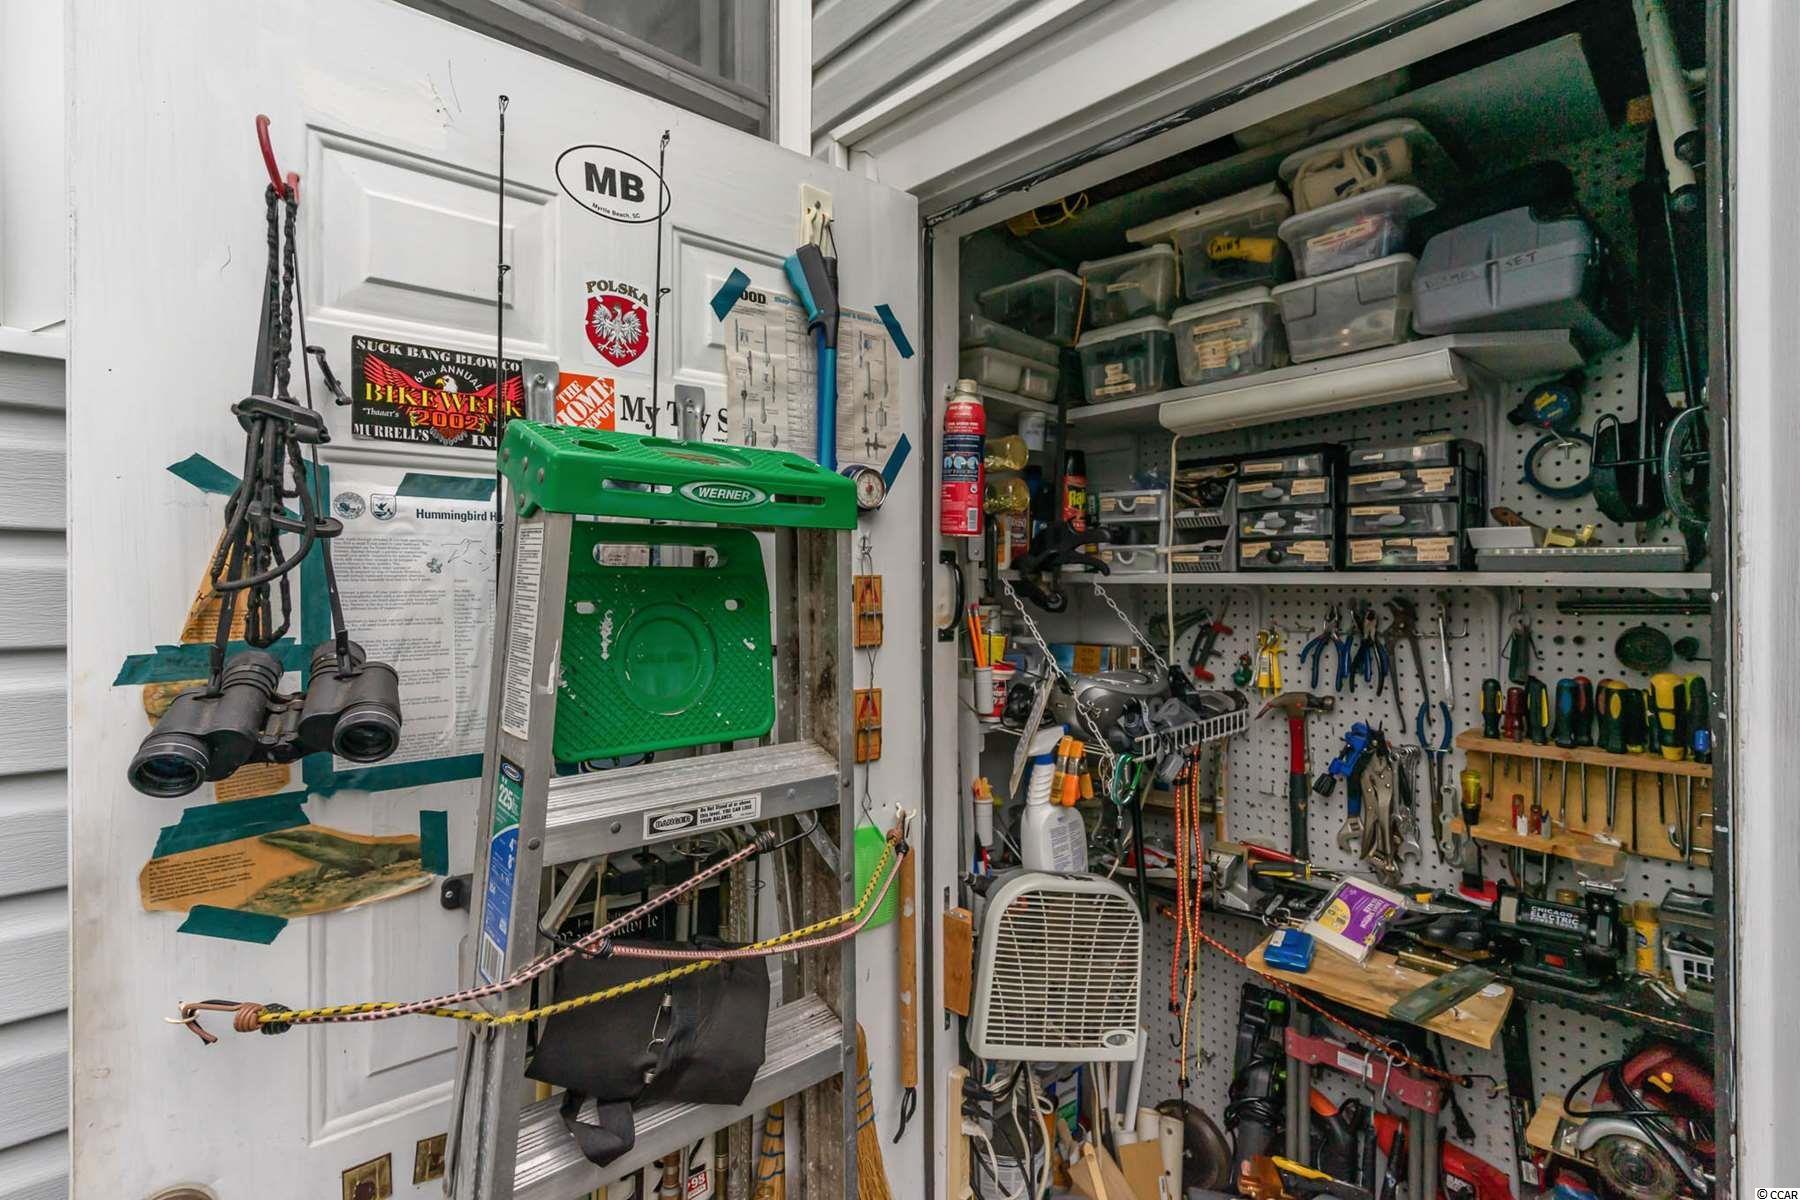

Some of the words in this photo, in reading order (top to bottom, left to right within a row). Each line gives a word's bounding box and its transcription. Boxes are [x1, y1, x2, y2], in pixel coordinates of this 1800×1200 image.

[584, 161, 645, 202] MB
[586, 280, 649, 307] POLSKA
[740, 289, 767, 305] OOD
[356, 339, 402, 355] SUCK
[407, 346, 451, 362] BANG
[456, 355, 498, 371] BLOW
[414, 367, 437, 383] 62nd
[440, 364, 483, 391] ANNUAL
[557, 380, 583, 406] THE
[557, 377, 612, 427] HOME
[415, 409, 480, 431] 2002
[579, 399, 615, 428] EPOT
[620, 394, 660, 430] My
[667, 400, 711, 435] Ty
[718, 408, 728, 433] S
[354, 423, 430, 442] MURRELL'S
[699, 486, 750, 501] WERNER
[416, 508, 487, 523] Hummingbird
[1530, 910, 1579, 926] ELECTRIC
[1531, 905, 1573, 919] CHICAGO
